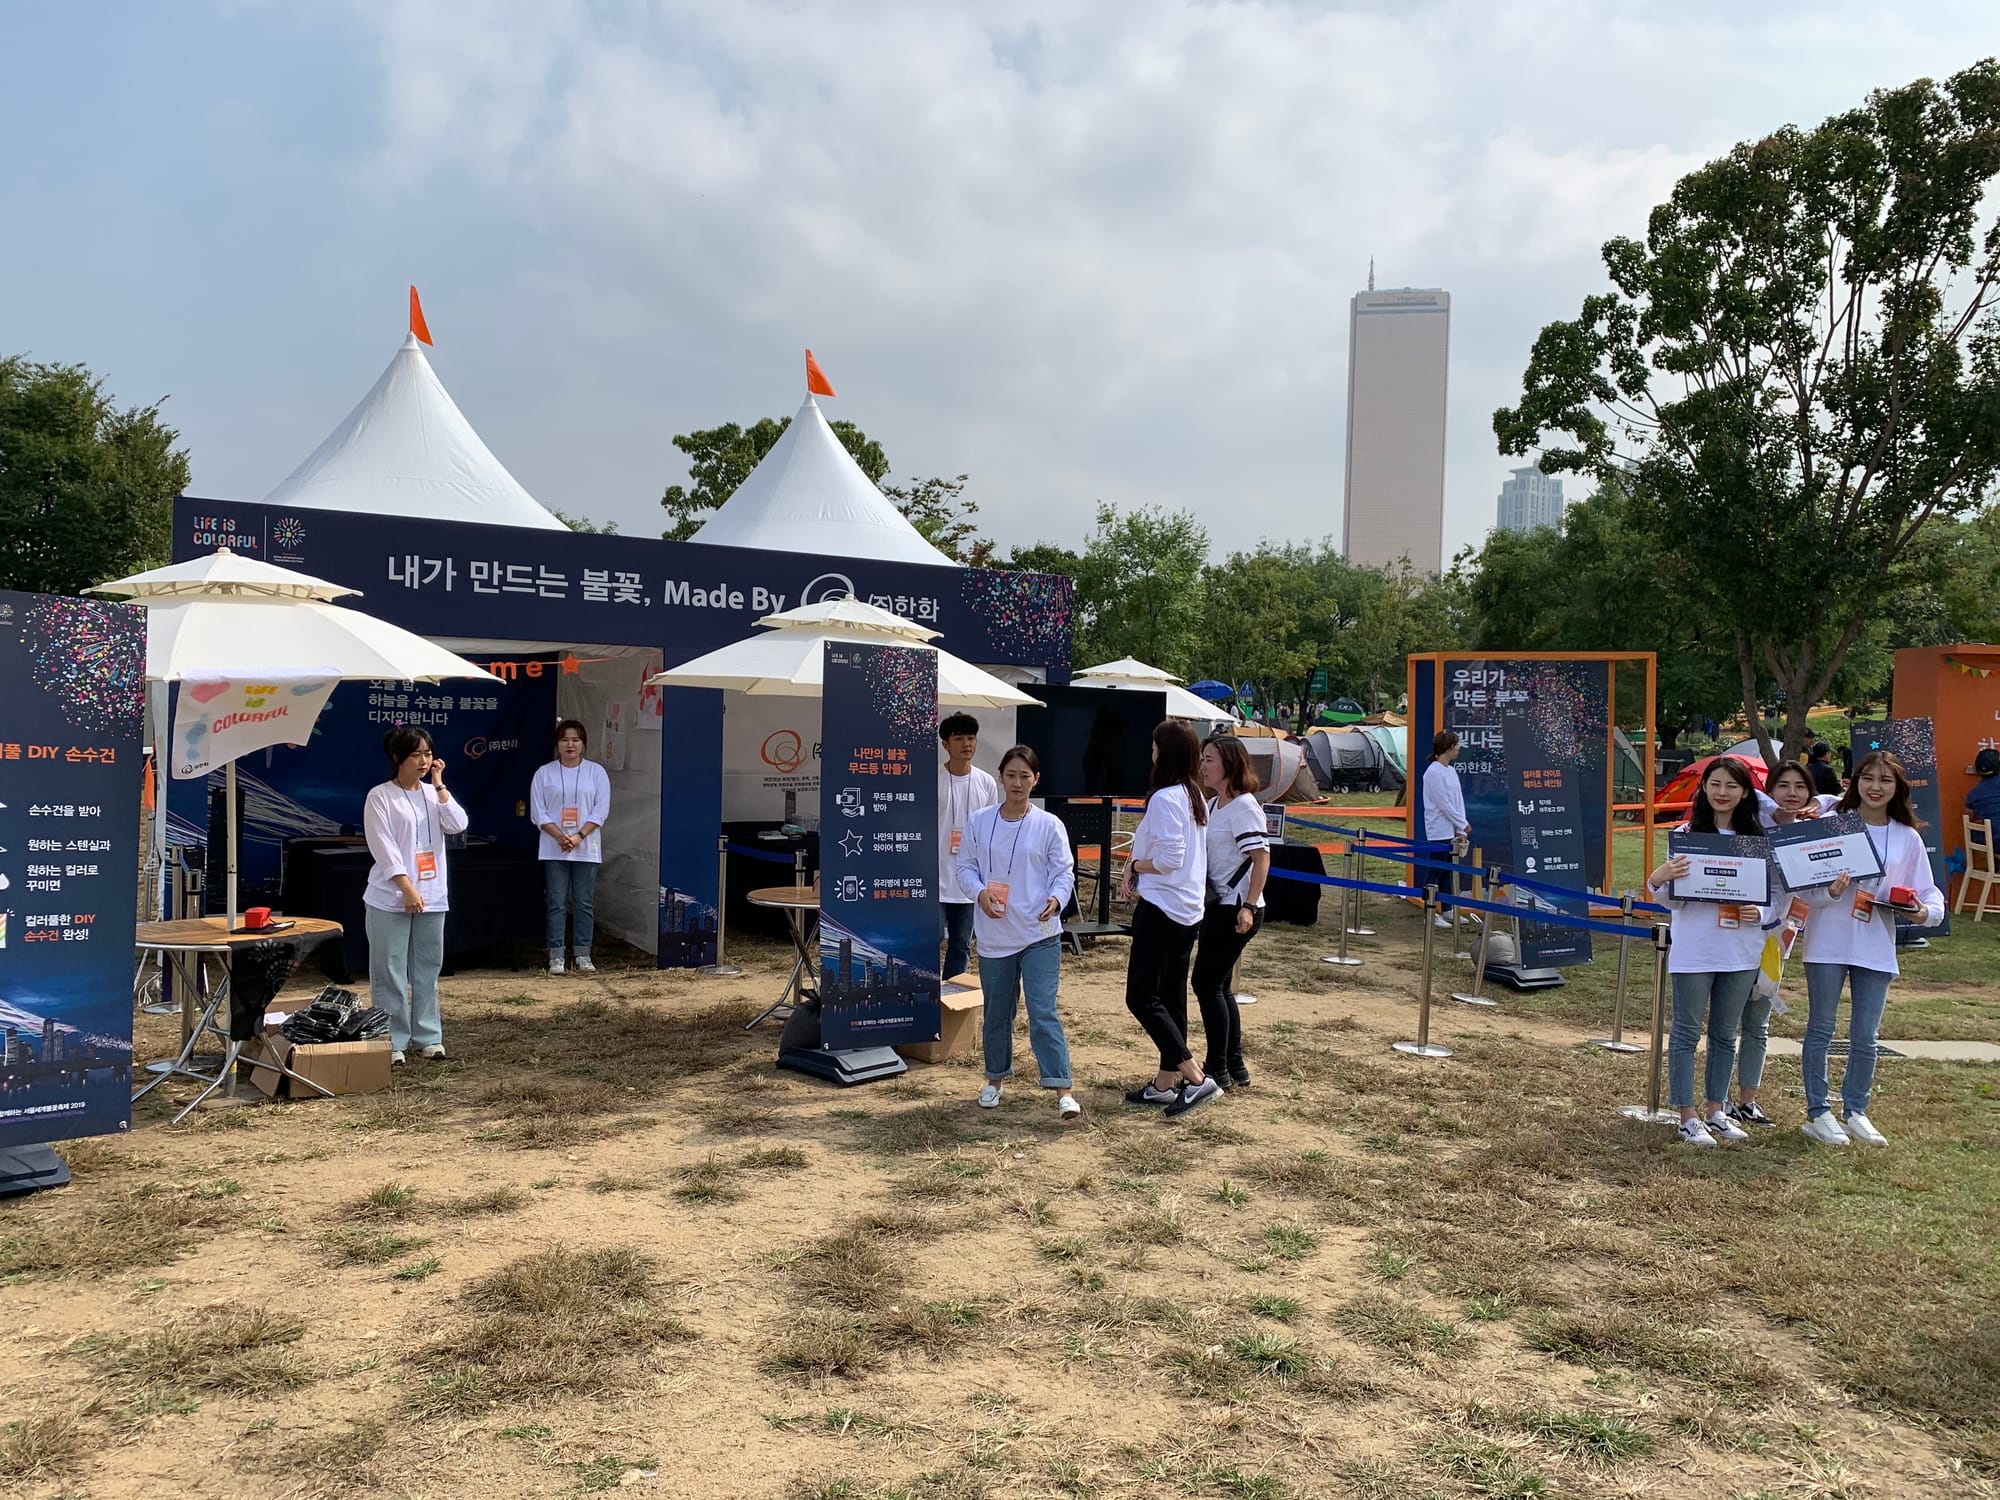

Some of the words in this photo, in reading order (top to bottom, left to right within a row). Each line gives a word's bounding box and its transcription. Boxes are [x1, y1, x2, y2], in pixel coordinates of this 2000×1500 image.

[193, 532, 258, 549] COLORFUL
[388, 555, 457, 592] 내가
[469, 560, 569, 599] 만드는
[580, 568, 651, 607] 불꽃,
[664, 579, 744, 610] Made
[751, 586, 786, 614] By
[1453, 669, 1506, 687] 우리가
[368, 693, 410, 709] 하늘을
[414, 695, 454, 710] 수놓을
[459, 696, 499, 711] 불꽃을
[1453, 690, 1488, 707] 만든
[212, 705, 289, 734] COLORFUL
[368, 710, 449, 726] 디자인합니다
[1455, 730, 1504, 748] 빛나는
[28, 745, 60, 759] DIY
[65, 746, 115, 763] 손수건
[854, 747, 884, 760] 나만의
[887, 748, 907, 760] 불꽃
[848, 762, 879, 775] 무드등
[882, 763, 912, 776] 만들기
[1454, 762, 1492, 774] (주)한화
[873, 792, 893, 802] 무드등
[28, 804, 75, 817] 손수건을
[78, 805, 101, 817] 받아
[873, 832, 894, 841] 나만의
[895, 832, 922, 841] 불꽃으로
[27, 839, 62, 852] 원하는
[65, 839, 111, 852] 스텐실과
[873, 843, 894, 852] 와이어
[26, 864, 62, 877] 원하는
[65, 864, 99, 877] 컬러로
[25, 880, 61, 892] 꾸미면
[873, 878, 900, 888] 유리병에
[911, 888, 927, 898] 완성!
[25, 914, 71, 927] 컬러풀한
[74, 914, 96, 925] DIY
[24, 930, 59, 942] 손수건
[62, 929, 89, 941] 완성!
[70, 1101, 86, 1110] 2019
